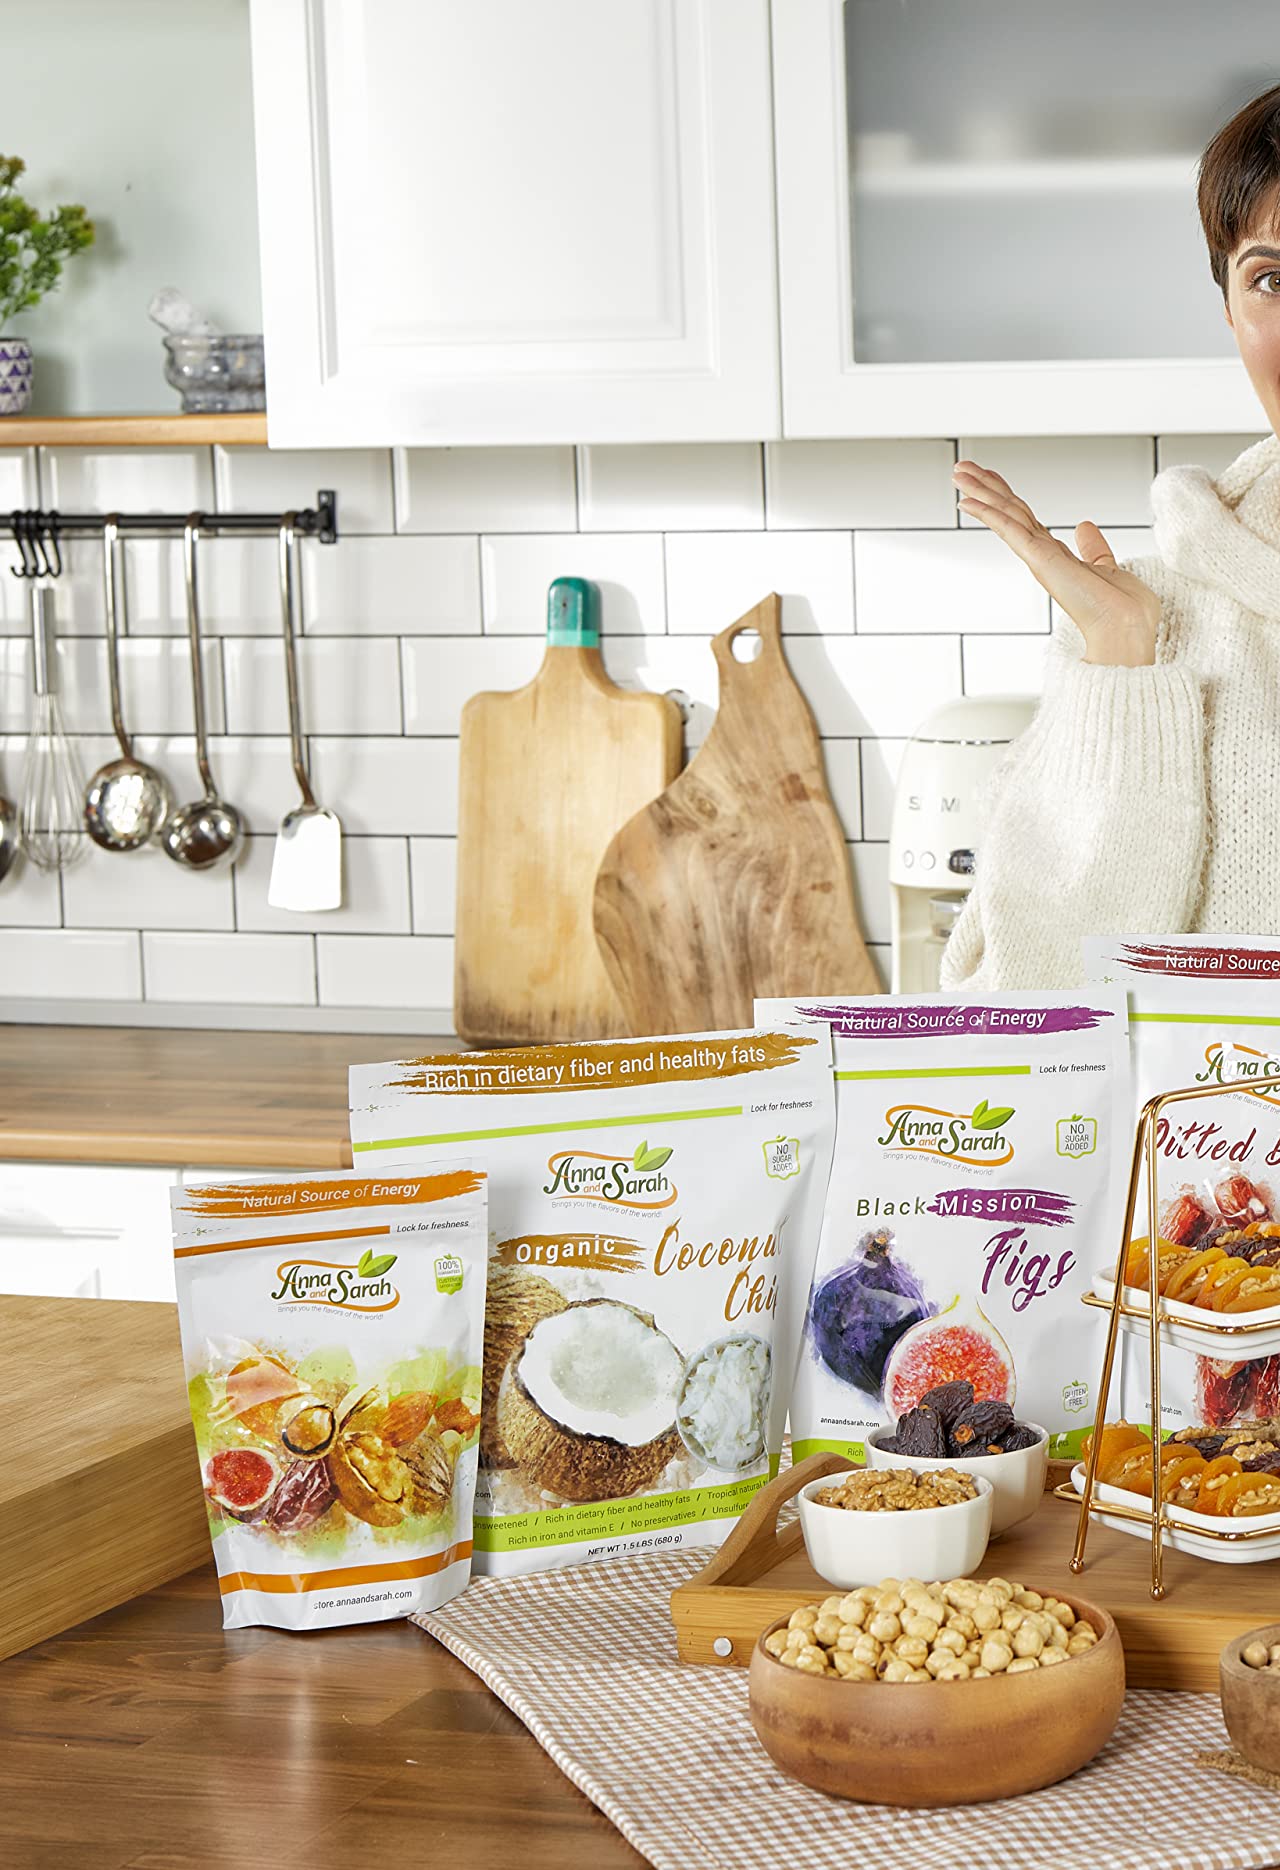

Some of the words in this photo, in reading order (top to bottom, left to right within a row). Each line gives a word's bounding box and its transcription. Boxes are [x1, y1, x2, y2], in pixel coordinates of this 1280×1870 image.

[1165, 954, 1223, 969] Natural
[1228, 955, 1280, 971] Source
[841, 1013, 902, 1030] Natural
[907, 1012, 964, 1028] Source
[969, 1011, 986, 1025] of
[990, 1011, 1046, 1028] Energy
[425, 1069, 468, 1088] Rich
[474, 1071, 492, 1086] in
[498, 1065, 564, 1083] dietary
[570, 1059, 614, 1077] fiber
[619, 1052, 654, 1074] and
[660, 1047, 725, 1070] healthy
[731, 1045, 765, 1064] fats
[1039, 1064, 1057, 1073] Lock
[1058, 1063, 1069, 1072] for
[1071, 1063, 1106, 1072] freshness
[1195, 1050, 1258, 1083] Ana
[751, 1104, 766, 1113] Lock
[769, 1102, 778, 1110] for
[780, 1100, 813, 1109] freshness
[878, 1111, 943, 1146] Anna
[1070, 1124, 1084, 1134] NO
[918, 1136, 936, 1146] and
[938, 1120, 1005, 1155] Sarah
[1065, 1134, 1089, 1142] SUGAR
[776, 1144, 789, 1155] NO
[1065, 1142, 1089, 1151] ADDED
[772, 1154, 792, 1163] SUGAR
[773, 1162, 792, 1172] ADDED
[543, 1157, 605, 1194] Anna
[602, 1162, 668, 1200] Sarah
[242, 1191, 296, 1209] Natural
[300, 1189, 350, 1203] Source
[353, 1185, 369, 1198] of
[372, 1183, 421, 1199] Energy
[584, 1183, 600, 1193] and
[552, 1201, 572, 1209] Brings
[598, 1202, 619, 1214] flavors
[620, 1208, 628, 1216] of
[629, 1209, 640, 1217] the
[857, 1197, 926, 1216] Black
[939, 1192, 1036, 1213] Mission
[397, 1224, 416, 1233] Lock
[418, 1223, 429, 1231] for
[431, 1220, 469, 1229] freshness
[516, 1234, 616, 1264] Organic
[437, 1260, 459, 1270] 100%
[982, 1227, 1076, 1312] Figs
[271, 1265, 331, 1300] Anna
[328, 1270, 391, 1304] Sarah
[309, 1289, 326, 1298] and
[724, 1263, 778, 1321] Chi
[298, 1305, 310, 1313] you
[323, 1306, 343, 1317] flavors
[344, 1311, 352, 1319] of
[1064, 1387, 1087, 1399] GLUTEN
[1068, 1397, 1083, 1406] FREE
[820, 1416, 880, 1428] annaandsarah.com
[847, 1447, 864, 1457] Rich
[546, 1514, 564, 1524] Rich
[566, 1513, 574, 1521] in
[576, 1509, 605, 1522] dietary
[607, 1506, 625, 1516] fiber
[628, 1503, 642, 1512] and
[644, 1499, 674, 1512] healthy
[676, 1495, 691, 1505] fats
[707, 1488, 738, 1502] Tropical
[740, 1483, 762, 1496] natural
[508, 1536, 528, 1546] Rich
[530, 1534, 537, 1543] in
[540, 1532, 556, 1542] iron
[558, 1529, 574, 1539] and
[576, 1526, 607, 1537] vitamin
[609, 1524, 615, 1532] E
[631, 1519, 642, 1528] No
[644, 1510, 696, 1528] preservatives
[712, 1502, 749, 1514] Unsulfur
[588, 1547, 604, 1556] NET
[607, 1544, 620, 1553] WT
[623, 1543, 635, 1551] 1.5
[637, 1540, 653, 1548] LBS
[654, 1535, 673, 1546] (680
[674, 1534, 682, 1544] g)
